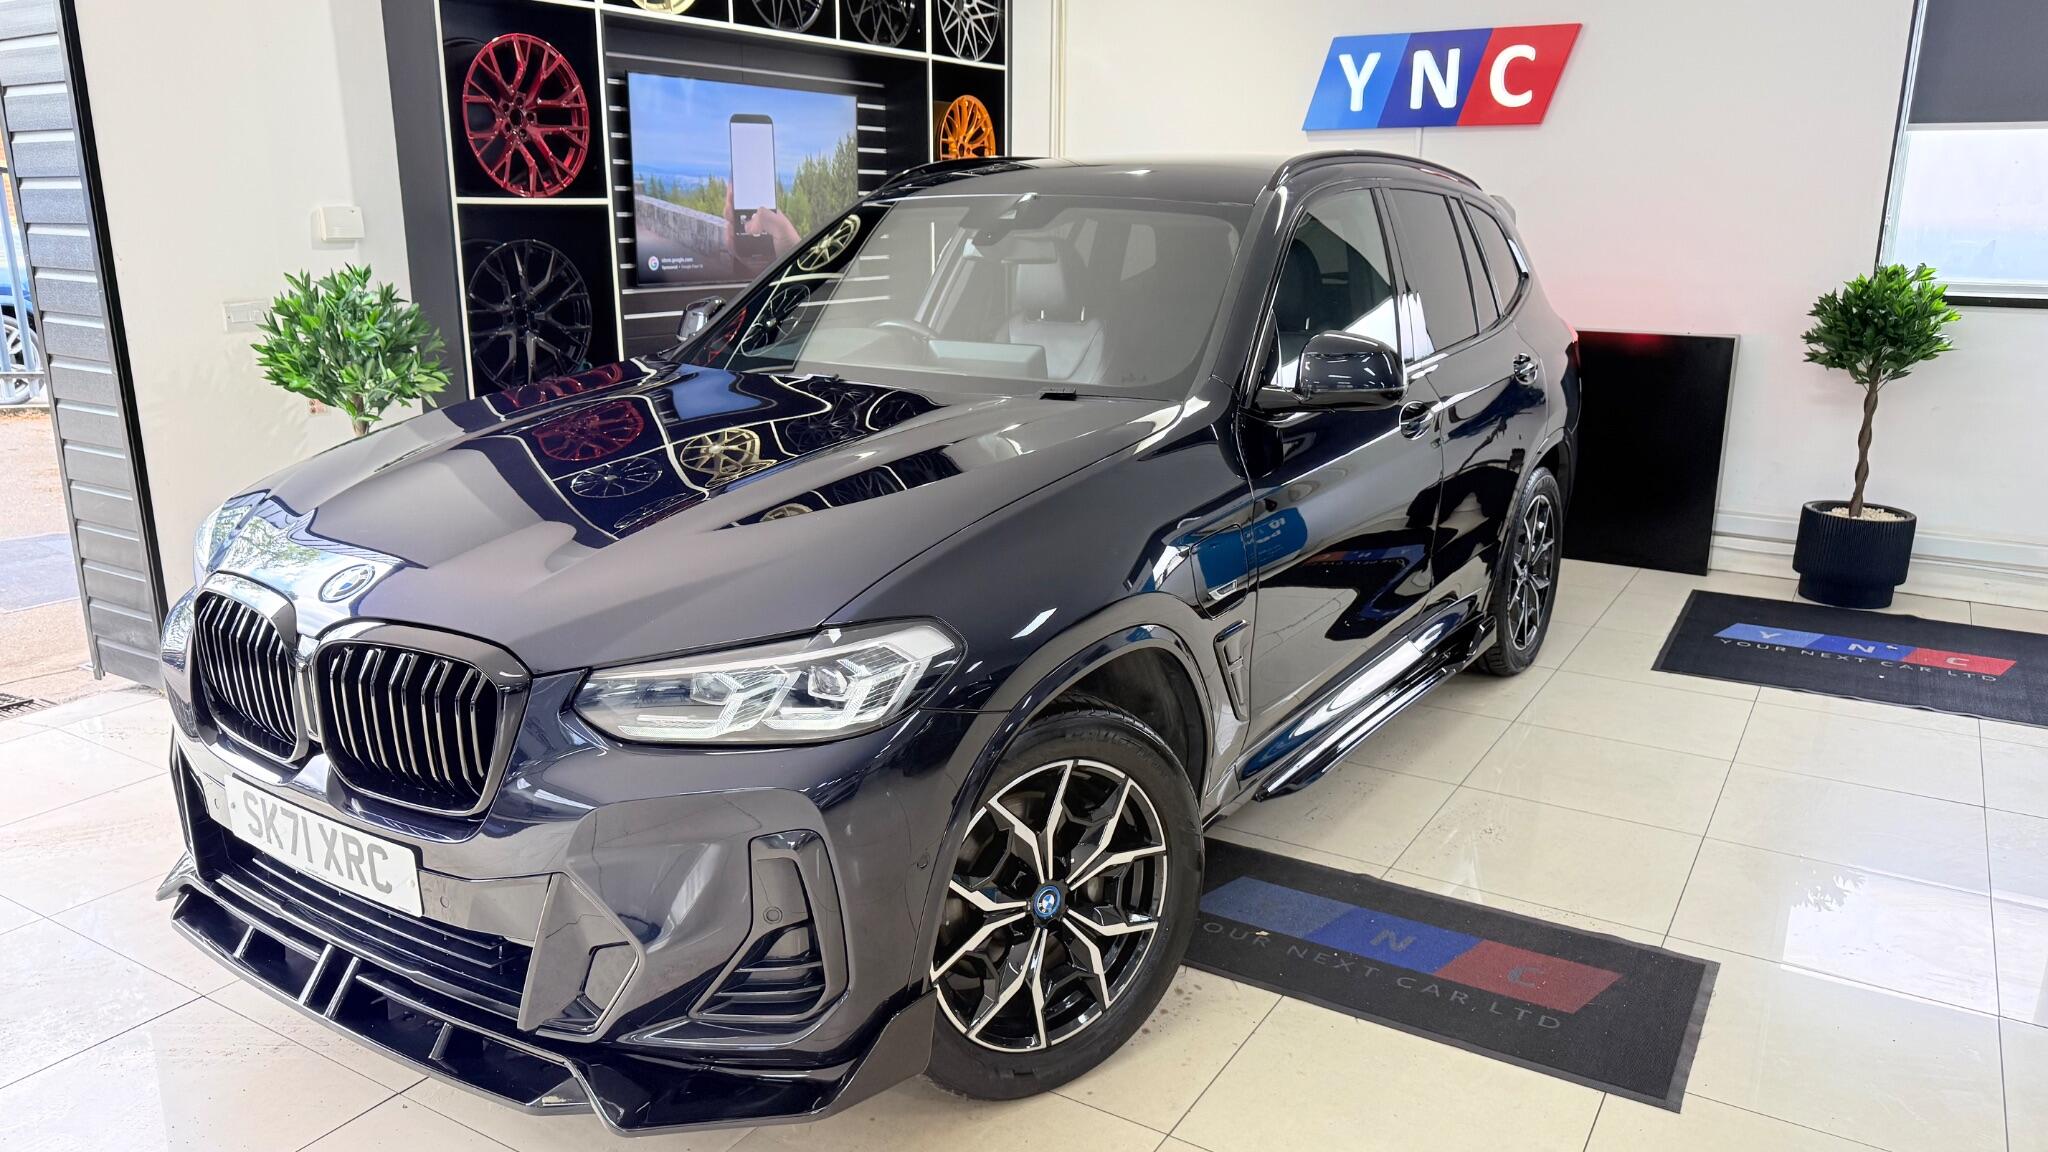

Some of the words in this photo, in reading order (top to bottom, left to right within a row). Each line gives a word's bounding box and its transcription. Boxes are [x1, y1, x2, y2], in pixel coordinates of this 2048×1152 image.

[1338, 44, 1536, 112] YNC
[1720, 638, 1787, 652] YOUR
[1800, 649, 1867, 663] NEXT
[1880, 660, 1932, 674] CAR
[1947, 669, 1997, 683] LTD
[243, 790, 314, 864] SK71
[317, 822, 393, 895] XRC
[1194, 917, 1272, 948] OUR
[1286, 944, 1381, 977] NEXT
[1396, 976, 1470, 1005] CAR
[1489, 1001, 1561, 1029] LTD
